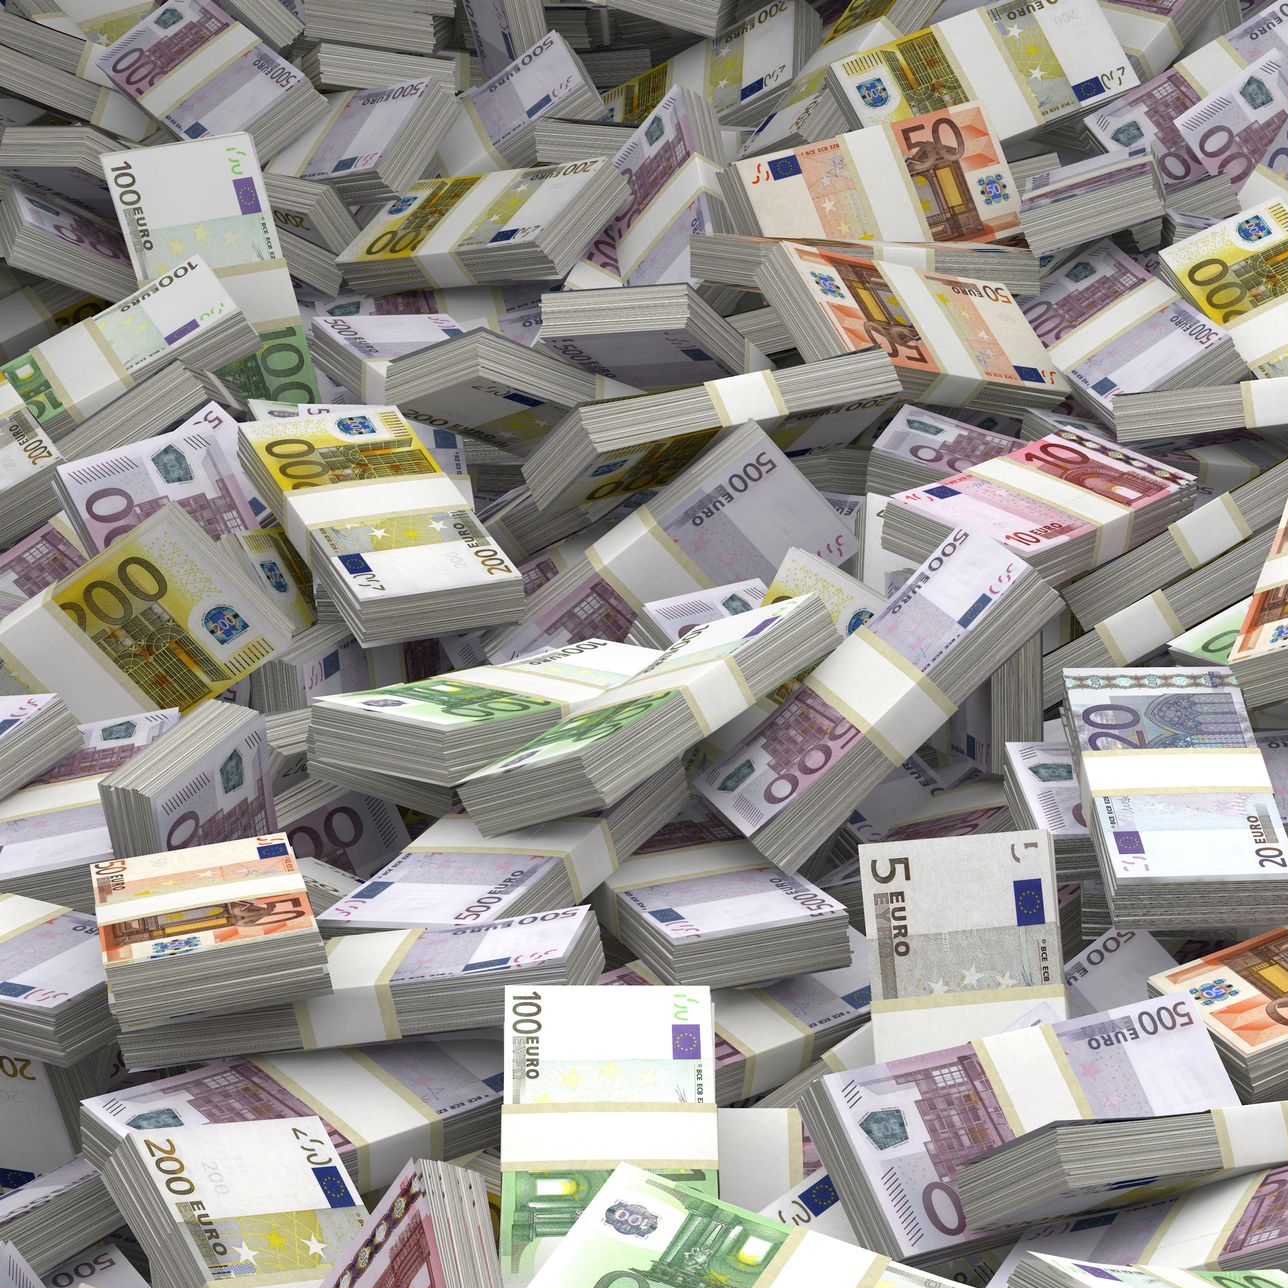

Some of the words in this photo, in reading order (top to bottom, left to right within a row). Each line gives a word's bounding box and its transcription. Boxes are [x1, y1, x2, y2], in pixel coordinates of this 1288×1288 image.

[362, 88, 391, 106] EURO
[389, 78, 427, 101] 500
[903, 118, 964, 159] 50
[111, 160, 141, 208] 100
[132, 205, 154, 251] EURO
[155, 260, 198, 288] 100
[120, 285, 156, 313] EURO
[950, 285, 983, 299] EURO
[980, 283, 1011, 304] 50
[9, 422, 29, 447] EURO
[22, 424, 53, 465] 200
[727, 451, 777, 492] 500
[1025, 442, 1090, 470] 10
[692, 485, 732, 526] EURO
[928, 528, 969, 572] 500
[1005, 528, 1039, 547] 10
[1030, 522, 1064, 538] EURO
[891, 574, 930, 616] EURO
[1080, 703, 1142, 748] 20
[1255, 815, 1271, 843] EURO
[94, 860, 125, 879] 50
[1258, 847, 1288, 868] 20
[870, 858, 910, 883] 5
[890, 892, 909, 956] EURO
[512, 991, 541, 1034] 100
[1142, 1002, 1193, 1038] 500
[1088, 1025, 1140, 1052] EURO
[526, 1037, 539, 1081] EURO
[144, 1139, 195, 1195] 200
[188, 1200, 227, 1255] EURO
